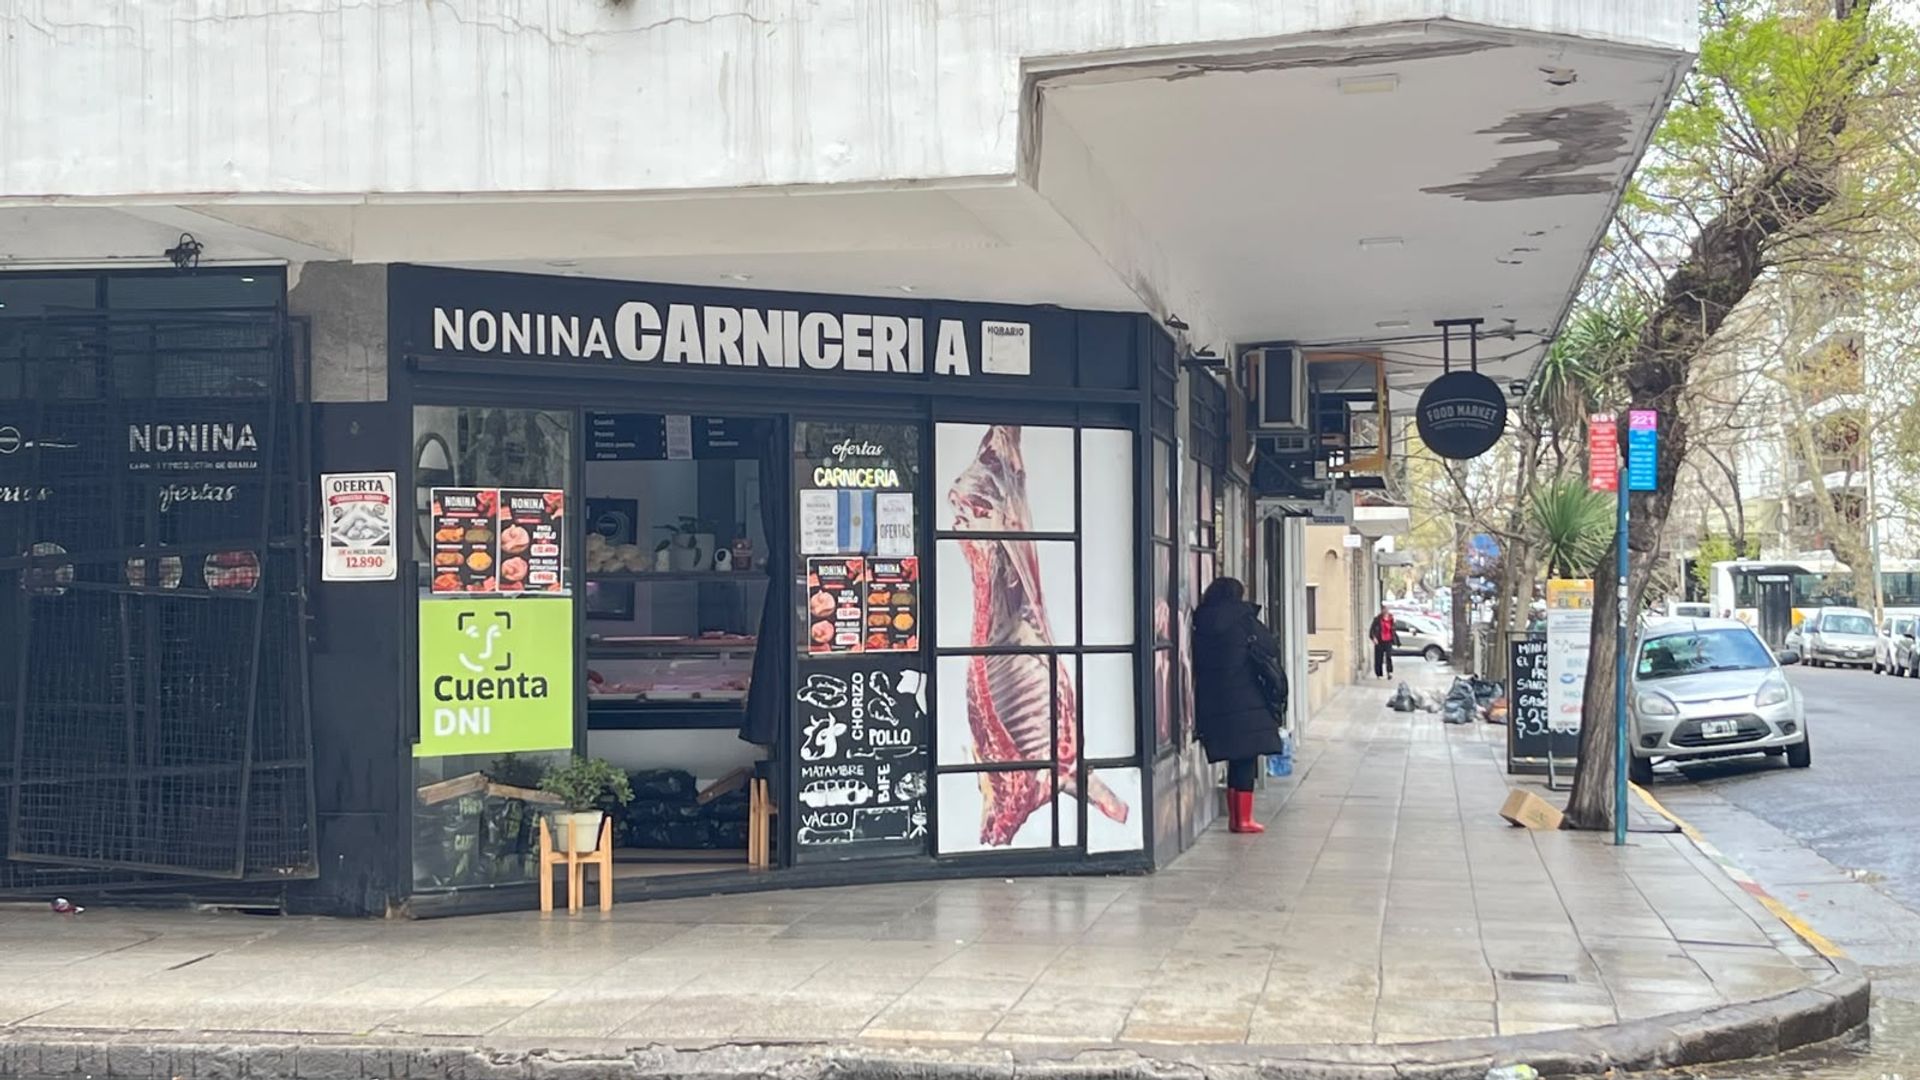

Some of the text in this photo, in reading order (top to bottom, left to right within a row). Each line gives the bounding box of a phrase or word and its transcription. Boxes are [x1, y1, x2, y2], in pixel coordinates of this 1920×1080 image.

[434, 307, 613, 359] NONINA
[987, 326, 1024, 336] HORARIO
[1426, 405, 1498, 422] FOOD MARKET
[129, 424, 257, 452] NONINA
[832, 439, 884, 462] ofertas
[333, 479, 385, 493] OFERTA
[813, 467, 900, 488] CARNICERIA
[511, 498, 545, 510] NONINA
[434, 673, 548, 701] Cuenta
[851, 672, 864, 740] CHORIZO
[434, 706, 491, 736] DNI
[869, 728, 911, 745] POLLO
[801, 764, 865, 778] MATAMBRE
[877, 763, 890, 804] BIFE
